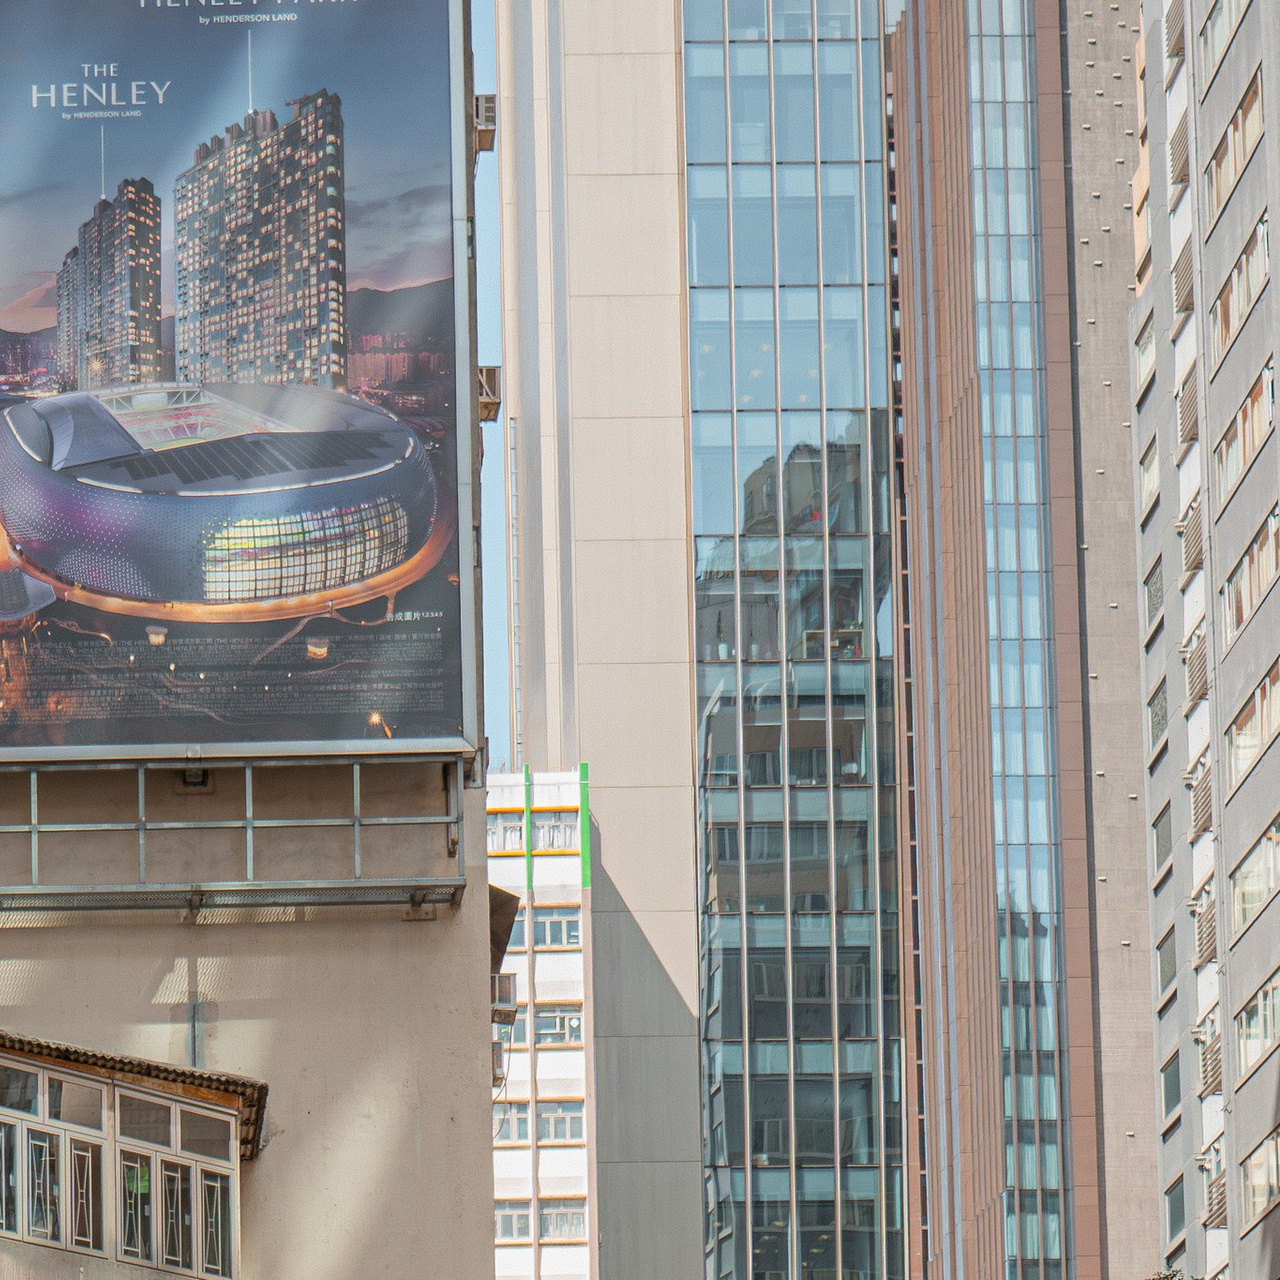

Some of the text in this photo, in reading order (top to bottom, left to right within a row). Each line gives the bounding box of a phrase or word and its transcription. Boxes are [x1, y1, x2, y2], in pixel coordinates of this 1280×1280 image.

[199, 13, 298, 25] by HENDERSON LAND
[81, 63, 119, 77] THE
[32, 81, 171, 108] HENLEY
[62, 110, 141, 120] by HENDERSON LAND
